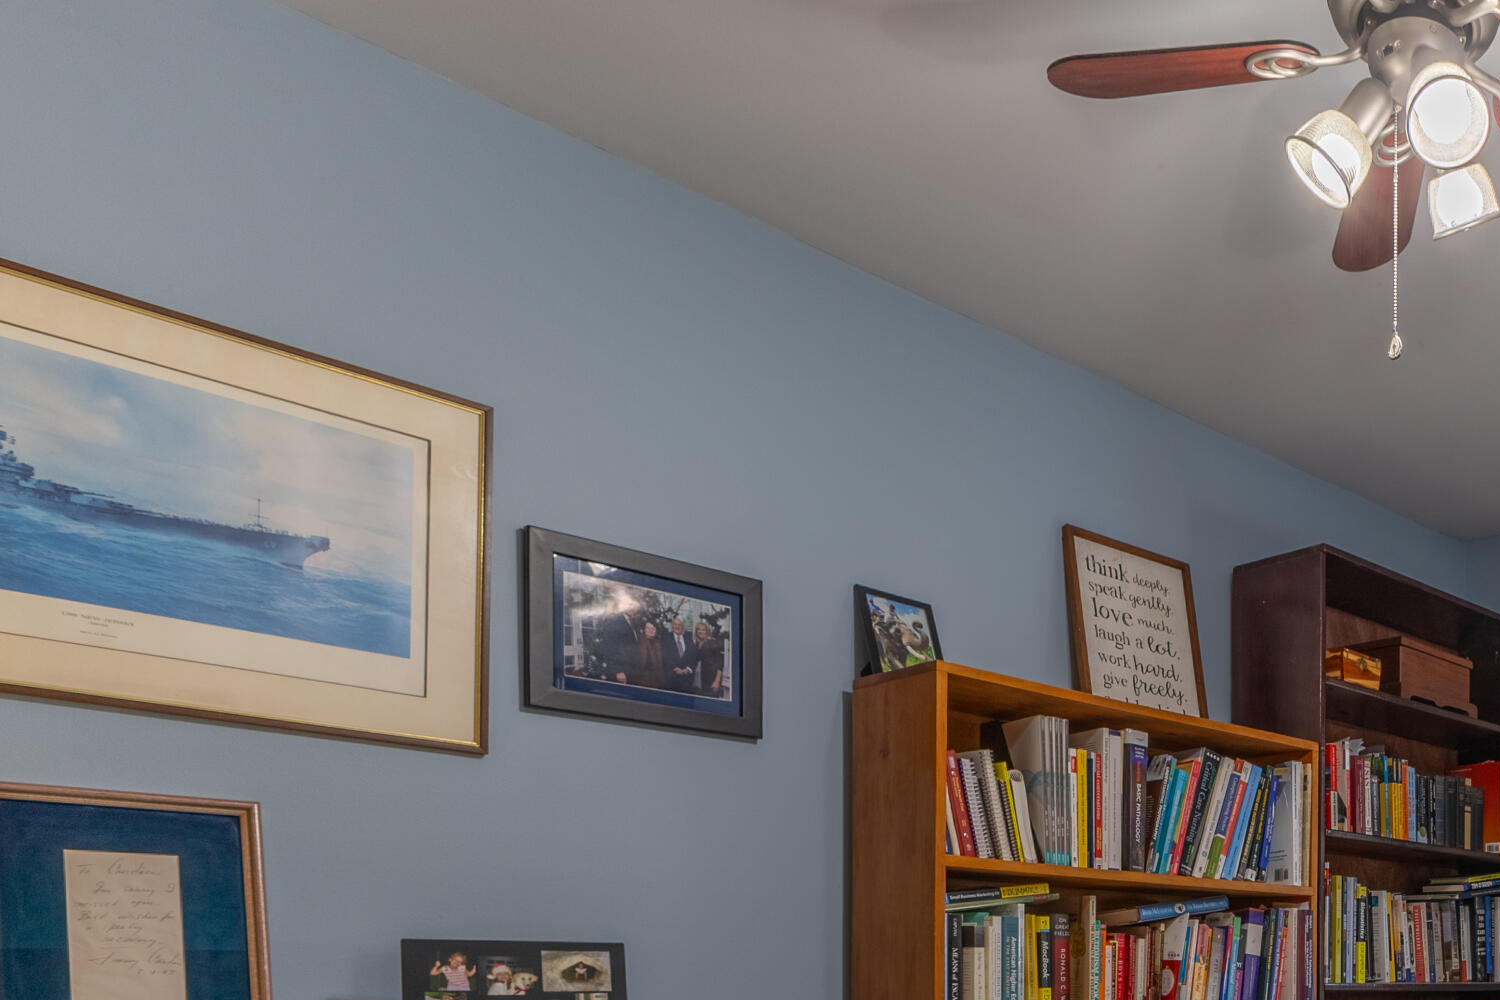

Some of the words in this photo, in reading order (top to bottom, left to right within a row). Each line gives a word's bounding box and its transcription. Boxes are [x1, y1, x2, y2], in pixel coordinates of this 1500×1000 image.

[1085, 555, 1129, 583] think
[1088, 580, 1126, 600] speak
[1092, 597, 1133, 627] love
[1094, 624, 1130, 649] laugh
[1135, 637, 1143, 649] a
[1148, 636, 1181, 660] lot.
[1098, 651, 1131, 669] work
[1133, 655, 1183, 682] hard.
[1103, 673, 1128, 688] give
[1133, 674, 1187, 705] freely.
[1199, 761, 1213, 790] Critical
[1195, 791, 1206, 810] Care
[1187, 811, 1202, 843] Nursing
[1009, 970, 1017, 992] Higher
